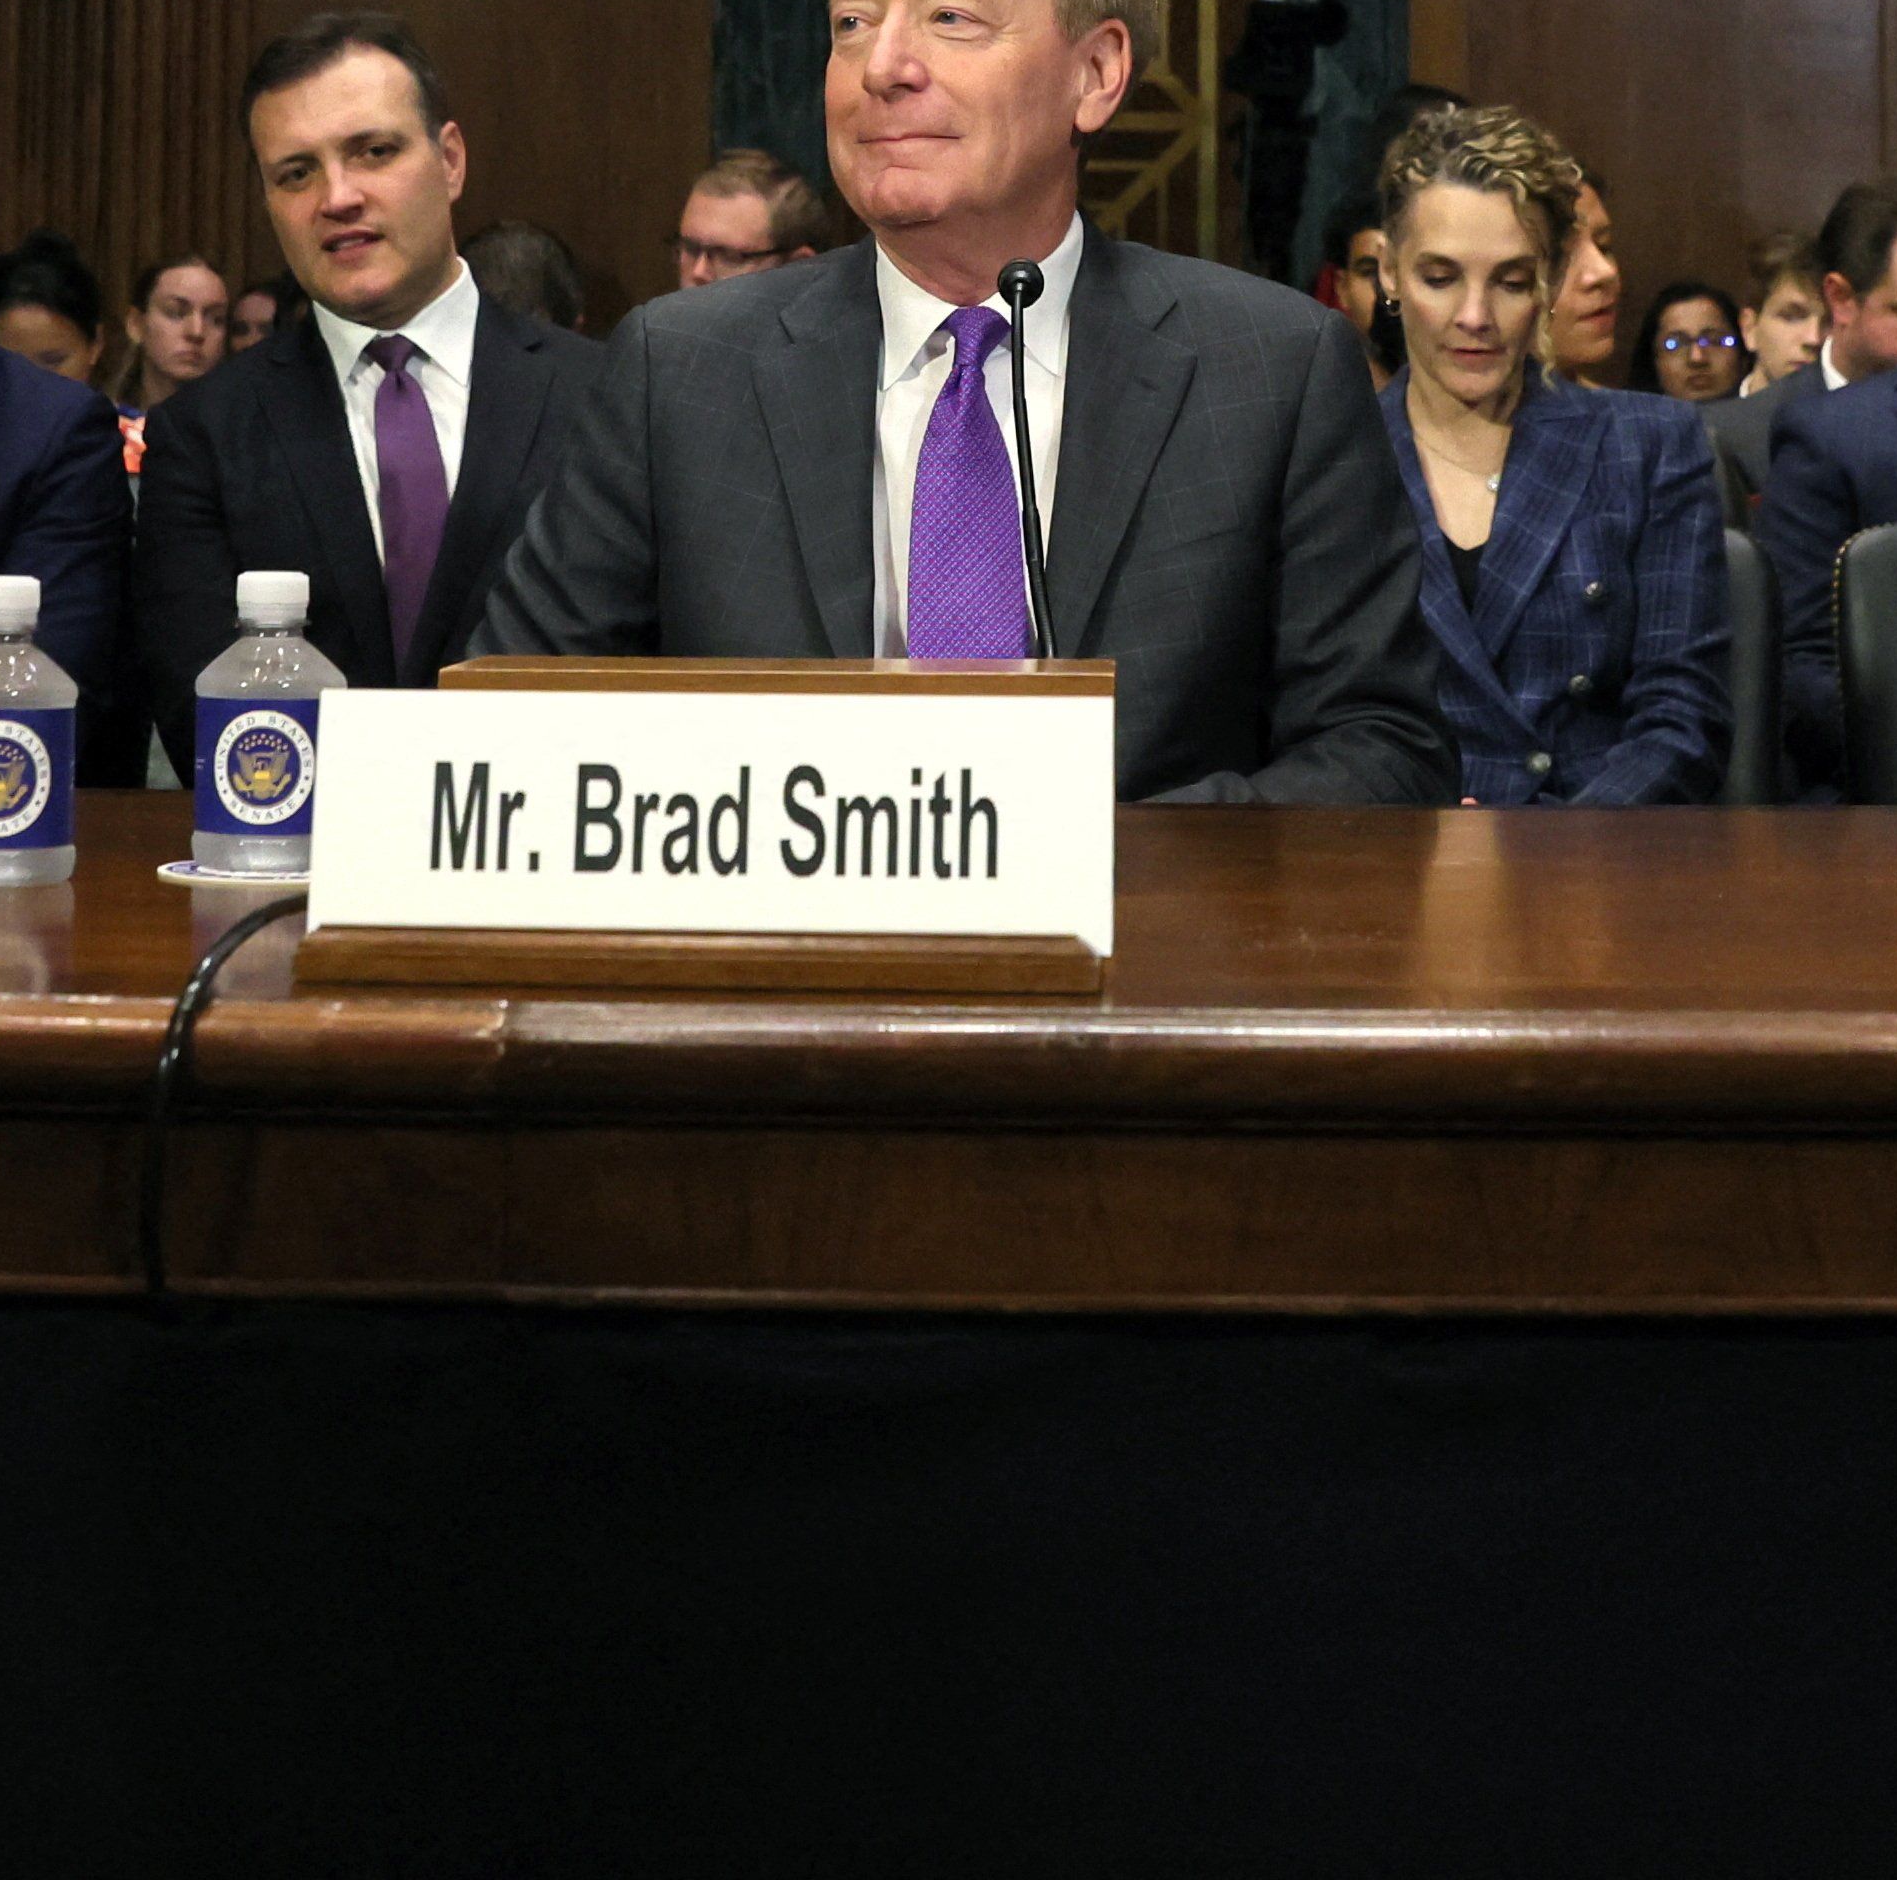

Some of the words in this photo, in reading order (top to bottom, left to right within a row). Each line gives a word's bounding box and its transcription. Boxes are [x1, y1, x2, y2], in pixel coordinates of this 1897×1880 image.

[217, 716, 256, 770] UNITED
[430, 761, 540, 874] Mr.
[573, 762, 751, 876] Brad
[780, 764, 999, 880] Smith
